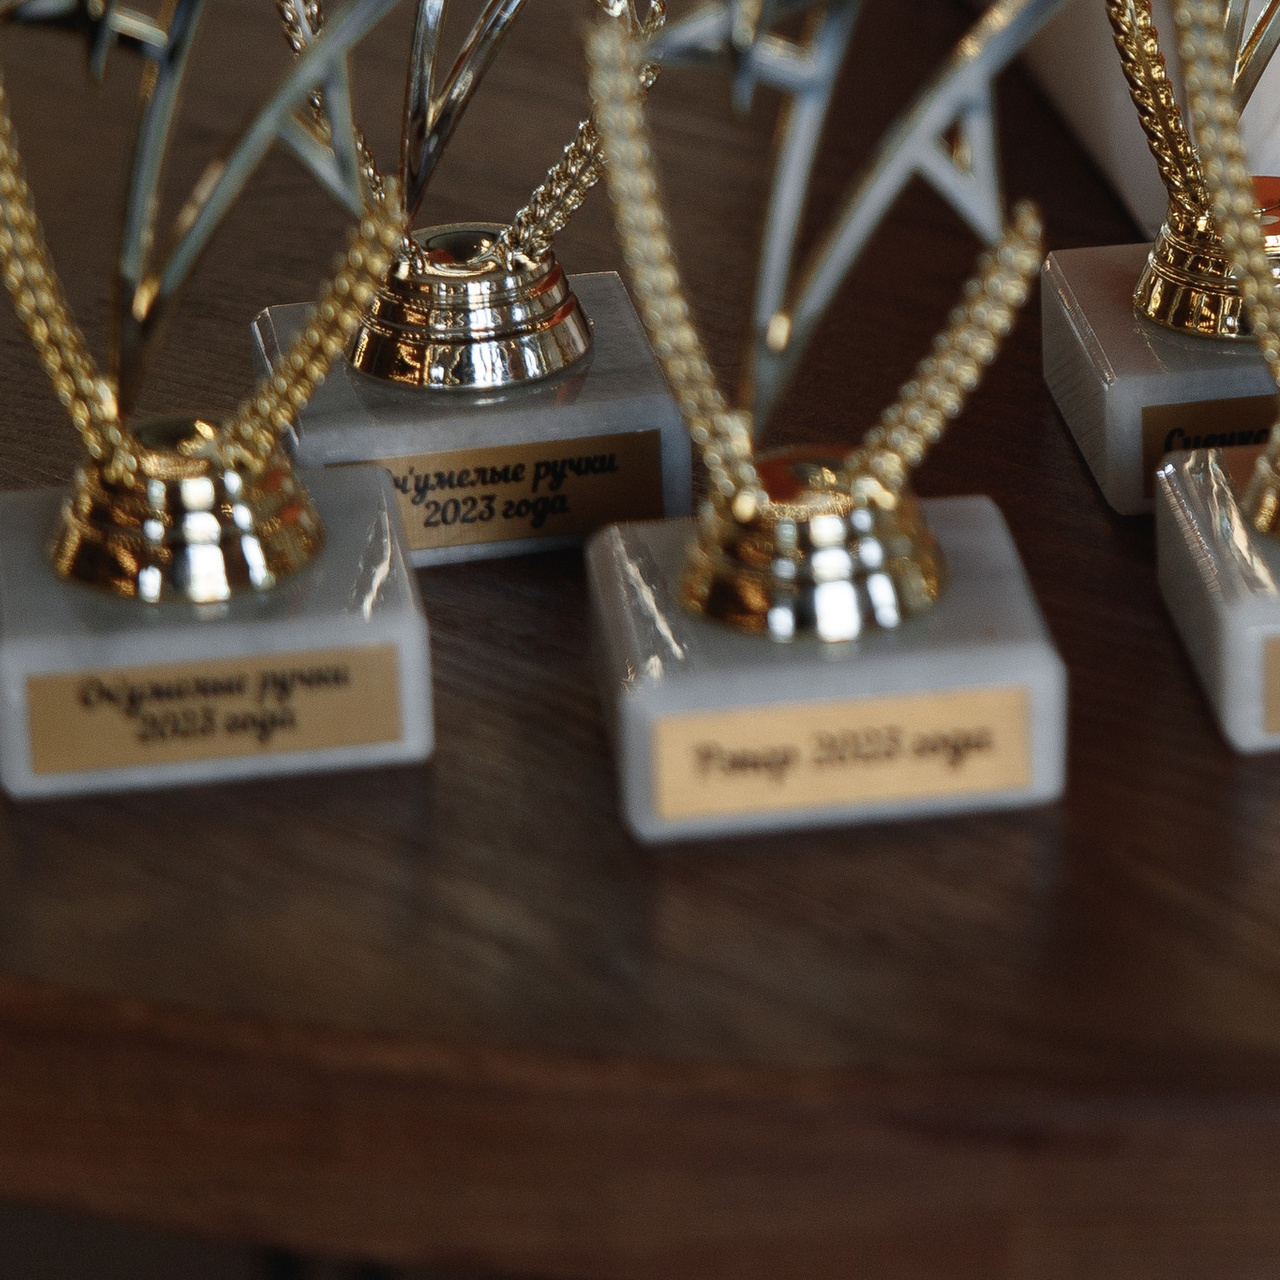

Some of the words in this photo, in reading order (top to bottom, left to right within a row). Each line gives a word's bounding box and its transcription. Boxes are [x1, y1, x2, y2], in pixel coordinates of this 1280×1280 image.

[391, 463, 526, 506] ч'умелые
[531, 453, 619, 493] ручки
[423, 494, 497, 528] 2023
[502, 494, 571, 529] года
